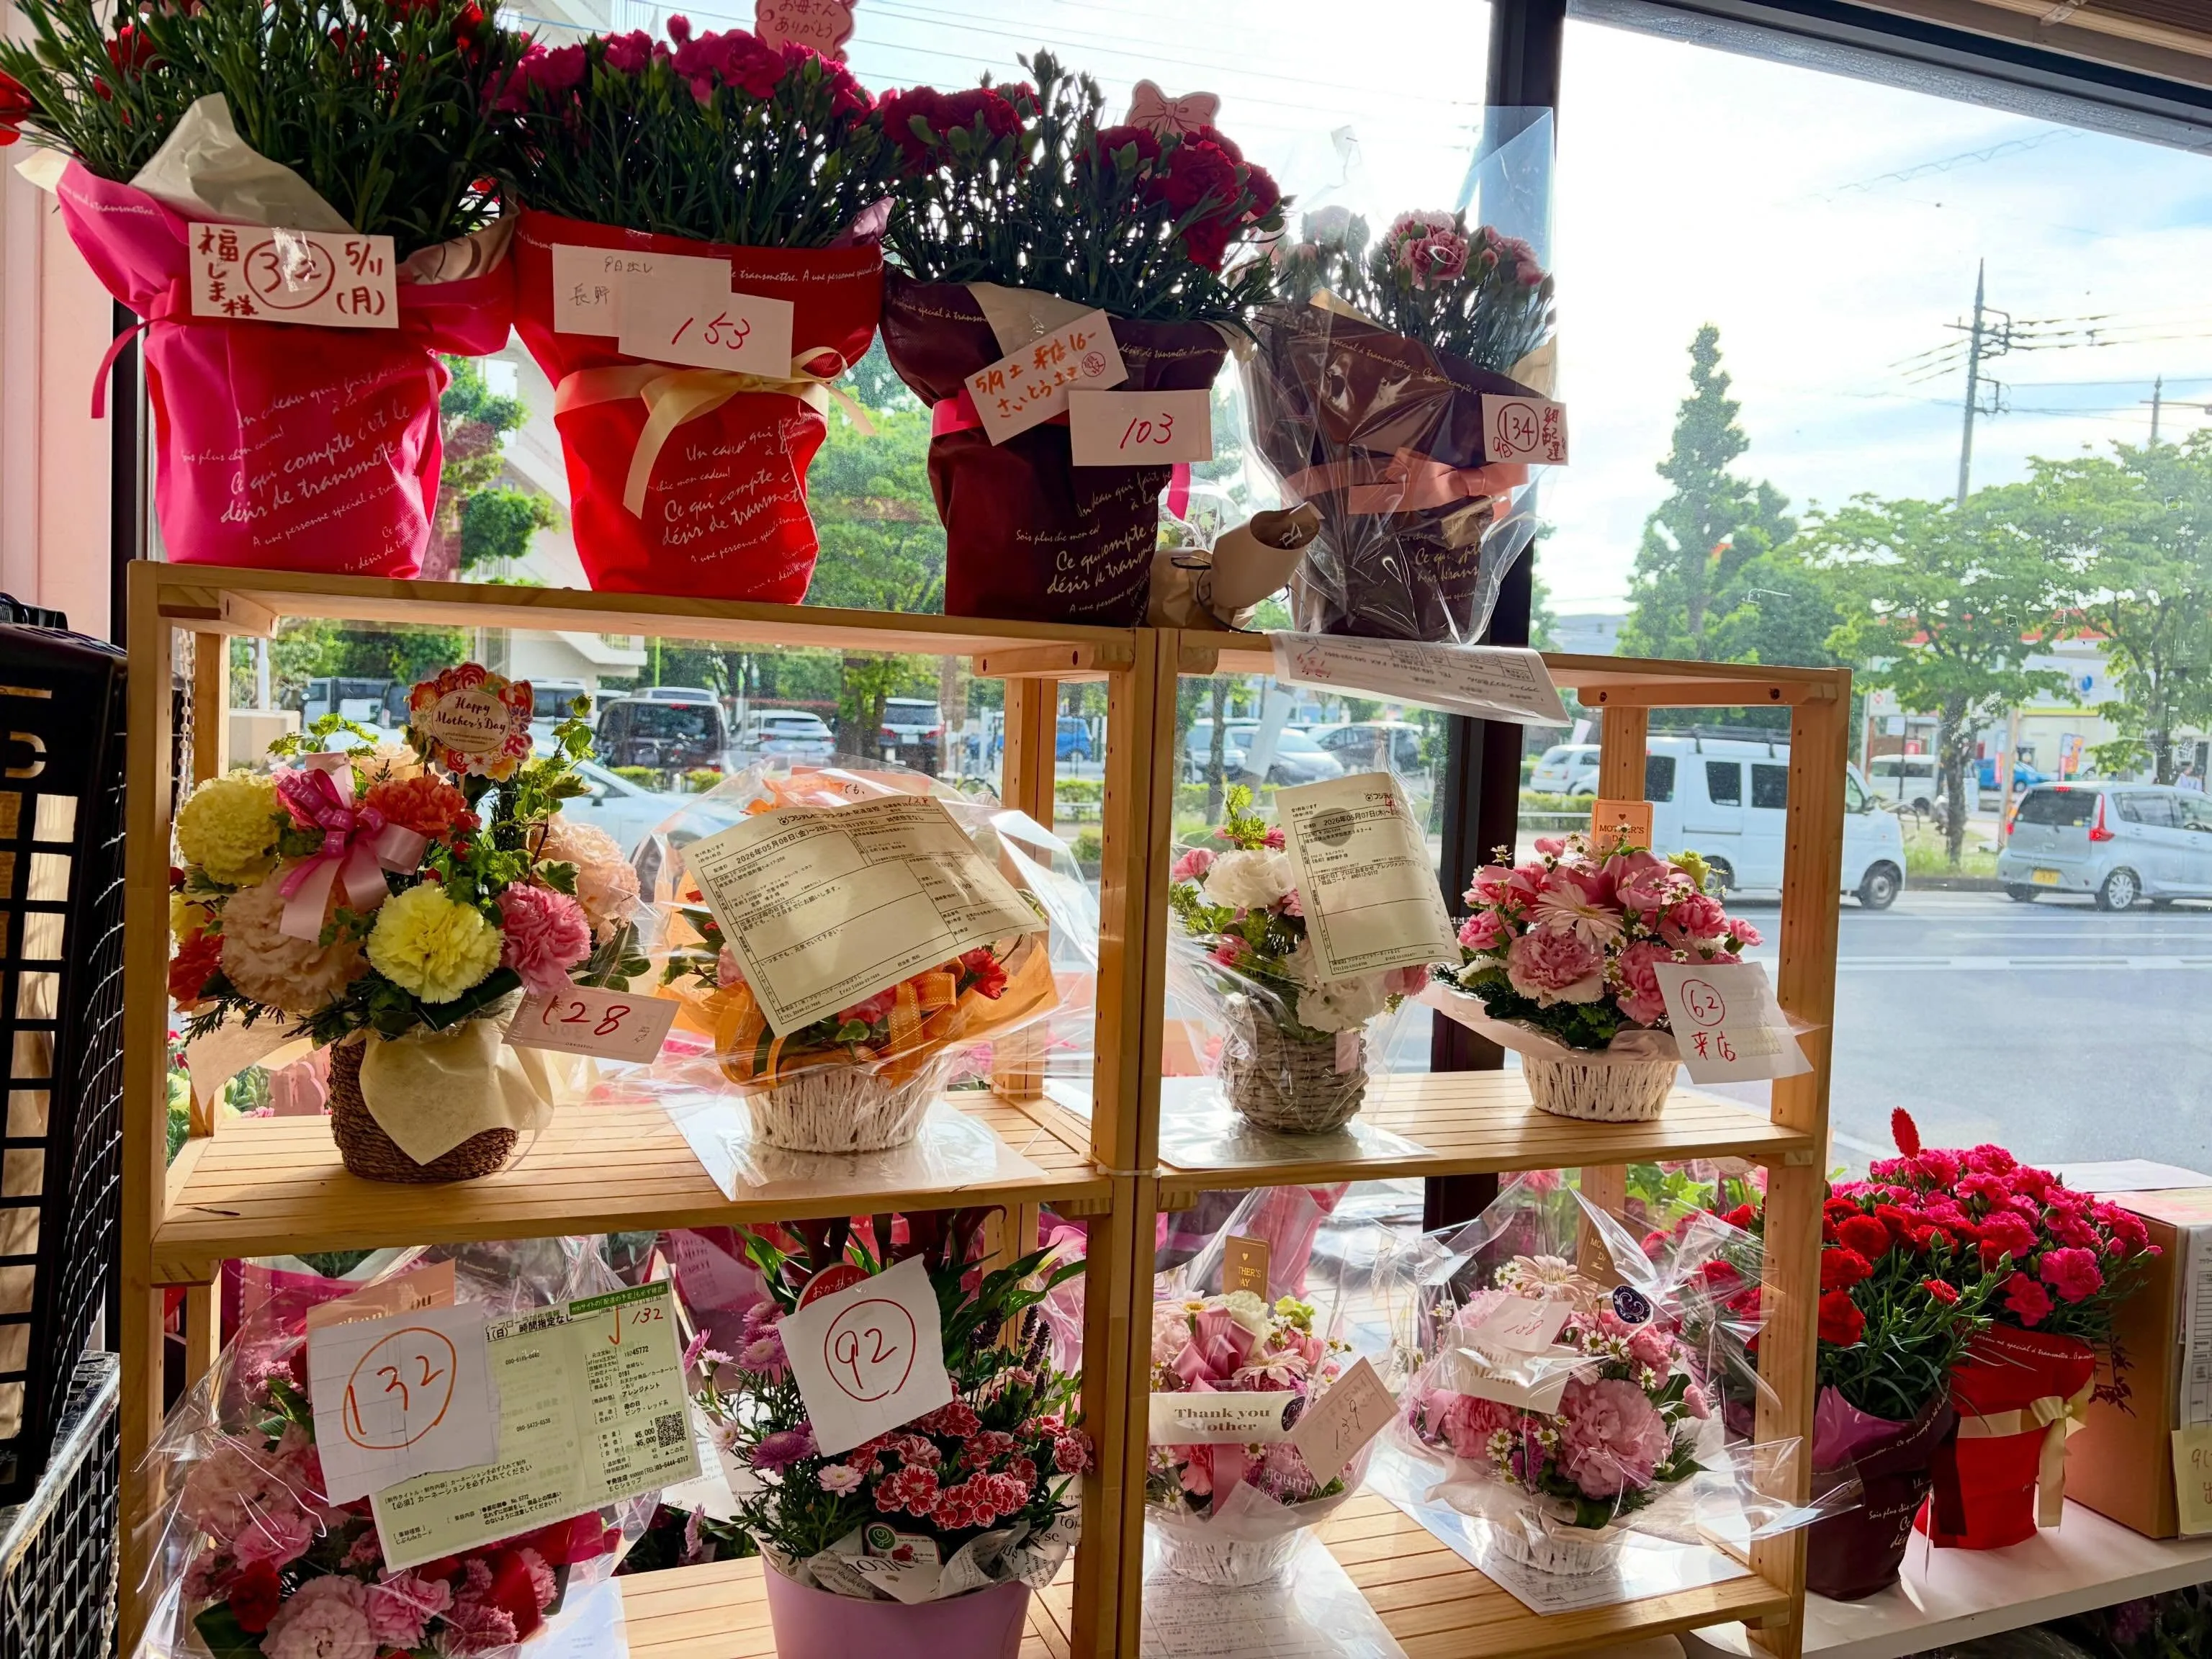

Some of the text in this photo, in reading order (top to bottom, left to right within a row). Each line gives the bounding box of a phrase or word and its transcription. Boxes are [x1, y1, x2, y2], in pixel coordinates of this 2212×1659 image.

[775, 17, 833, 39] ありがとう
[802, 269, 809, 282] A
[811, 273, 826, 282] une
[336, 286, 385, 315] (月)
[1119, 412, 1175, 450] 103
[1503, 410, 1536, 446] 134
[685, 444, 709, 462] Un
[749, 425, 774, 445] qui
[230, 470, 244, 495] Ce
[249, 469, 277, 498] qui
[283, 431, 355, 475] compte
[699, 466, 732, 482] cadeau!
[1137, 471, 1160, 493] fait
[220, 500, 268, 524] désir
[273, 485, 295, 511] de
[664, 467, 775, 523] Ce qui compte
[253, 536, 261, 548] A
[264, 532, 284, 546] une
[286, 511, 330, 541] personne
[662, 515, 729, 547] désir de
[1015, 529, 1033, 542] Sois
[1034, 531, 1053, 545] plus
[719, 538, 758, 560] personne
[1056, 549, 1076, 572] Ce
[1415, 547, 1430, 565] Ce
[1046, 574, 1092, 595] désir
[454, 696, 491, 716] Happy
[434, 710, 507, 735] Mother's Day
[1689, 988, 1719, 1019] 62
[1691, 1030, 1738, 1062] 来店
[518, 1313, 574, 1333] 時間指定なし
[631, 1307, 664, 1325] 132
[835, 1327, 899, 1390] 92
[348, 1354, 445, 1436] 132
[621, 1382, 660, 1398] アレンジメント
[624, 1400, 641, 1410] 母の日
[1174, 1407, 1271, 1421] Thank you
